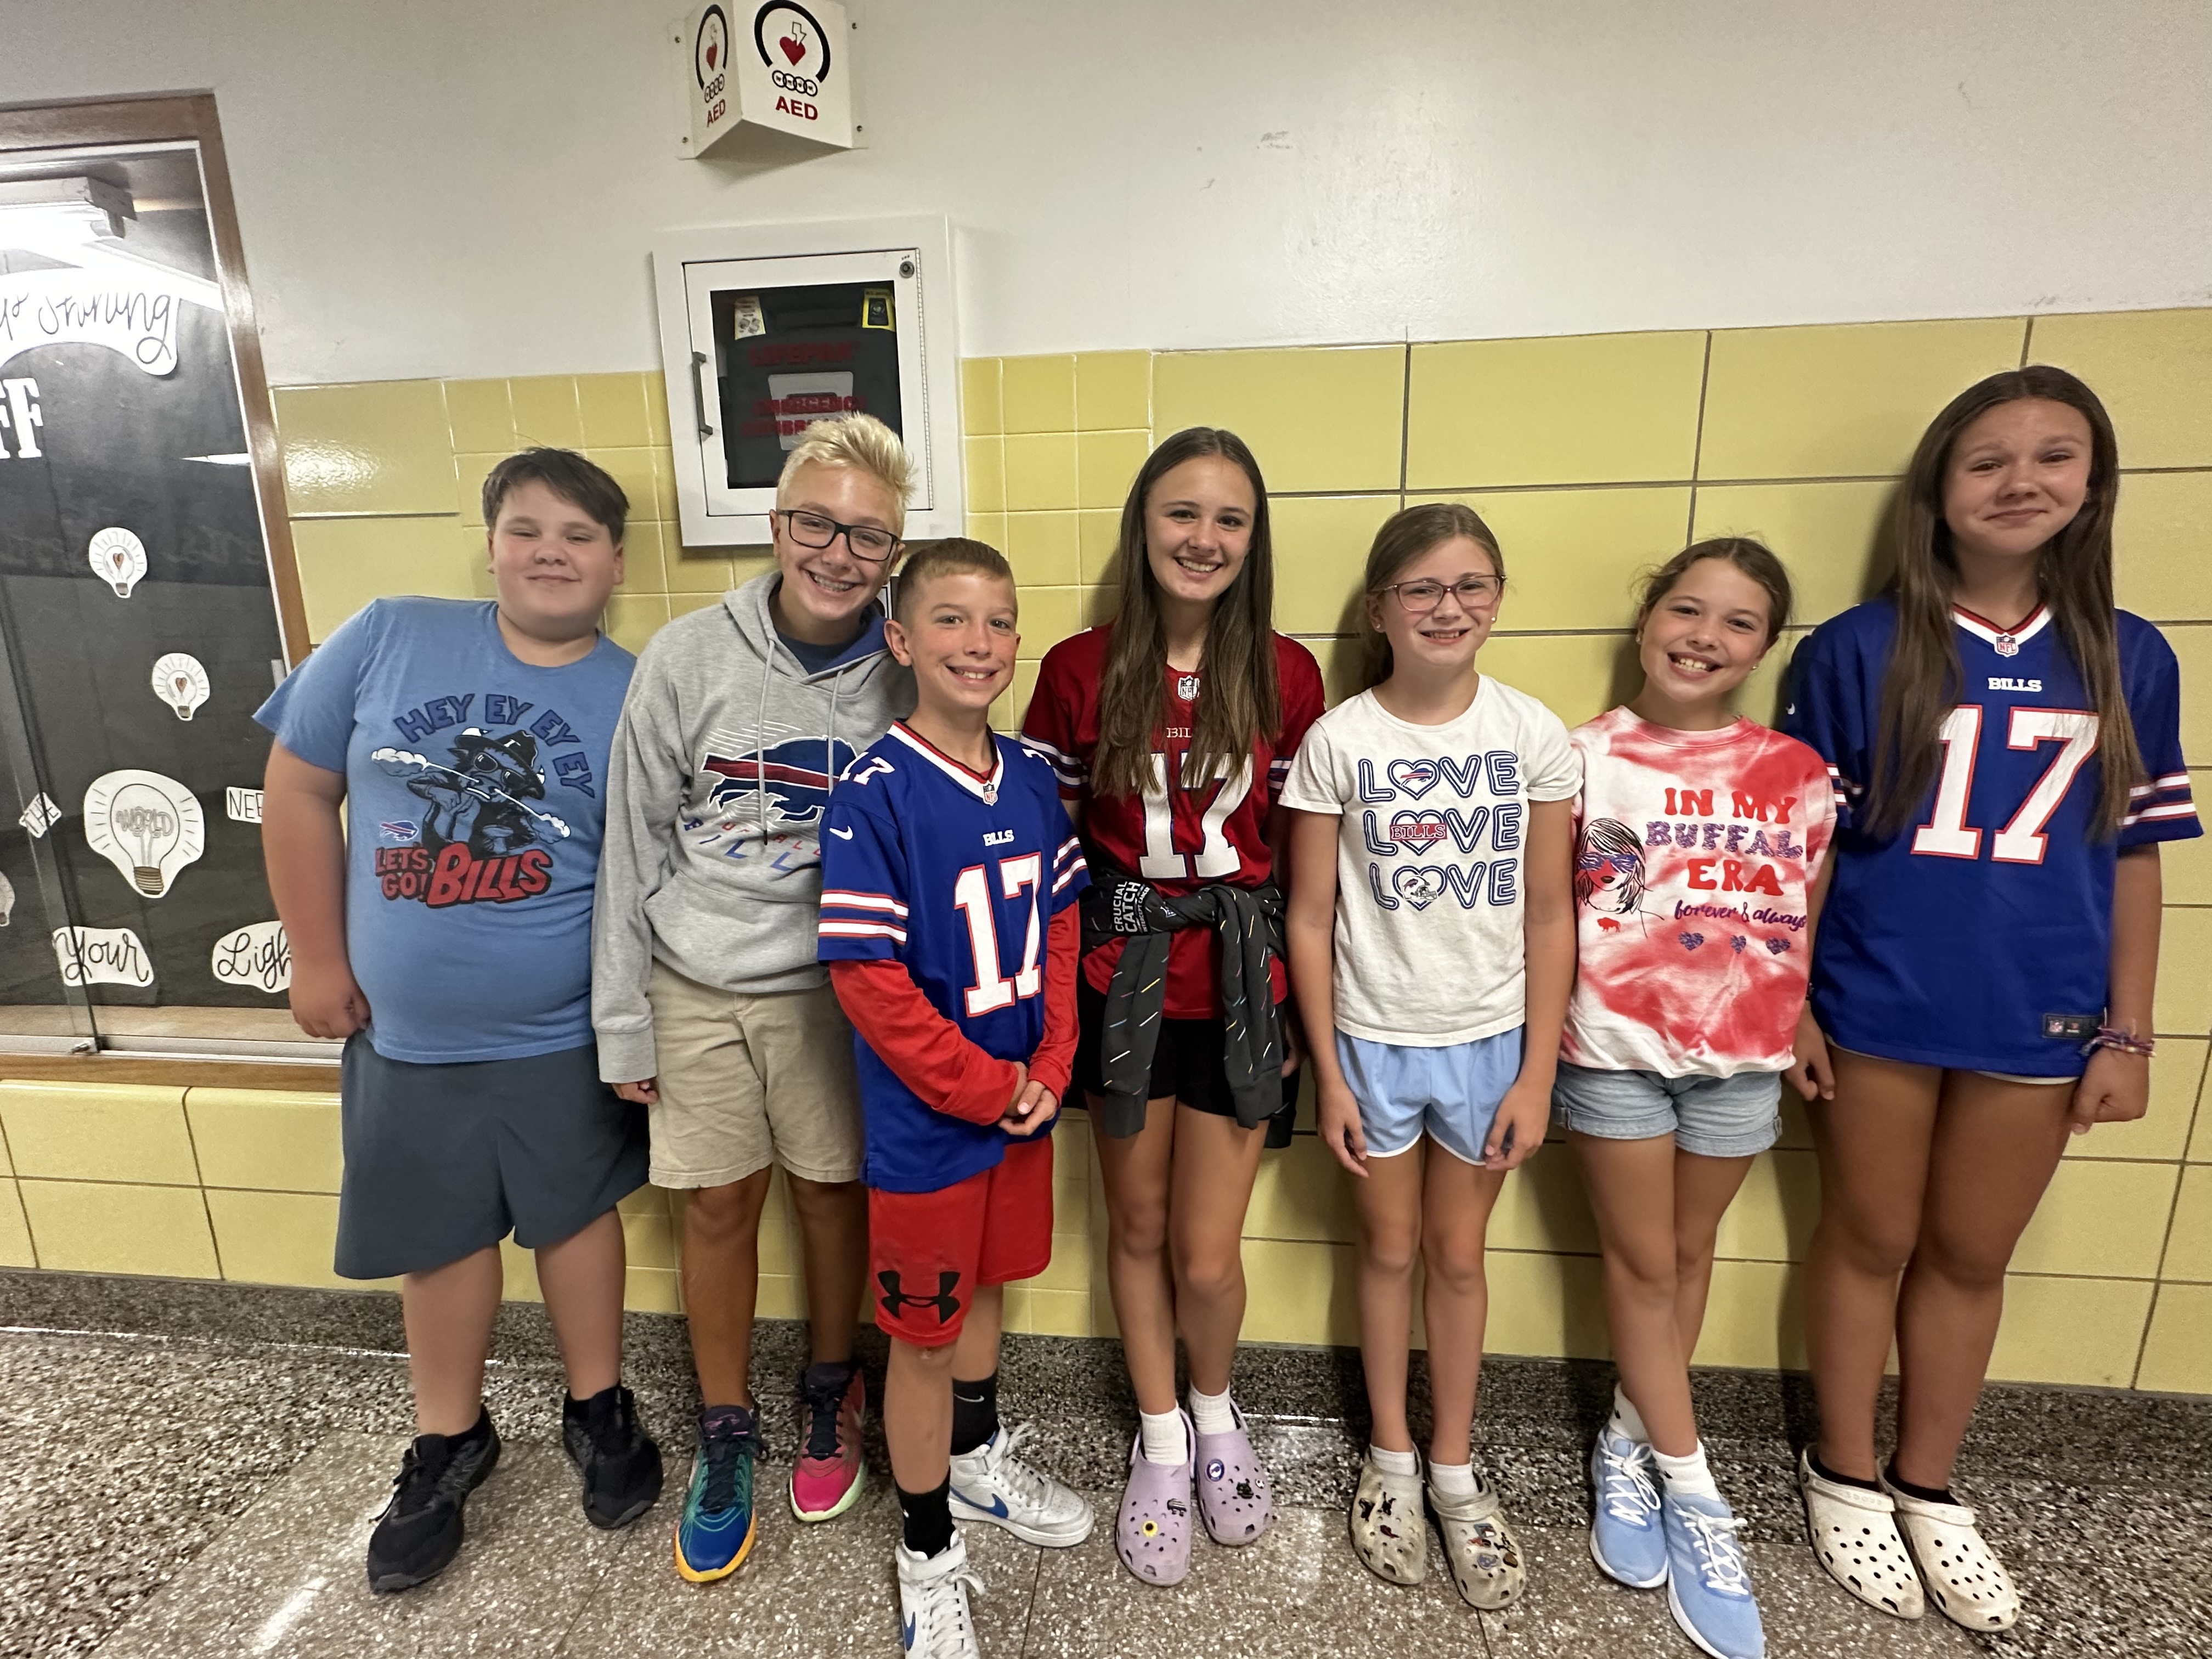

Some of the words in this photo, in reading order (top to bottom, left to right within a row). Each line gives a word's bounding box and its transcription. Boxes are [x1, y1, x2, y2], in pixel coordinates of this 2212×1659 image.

[707, 99, 725, 127] AED
[776, 96, 818, 120] AED
[1988, 677, 2042, 692] BILLS
[393, 693, 475, 743] HEY
[485, 693, 534, 725] EY
[529, 709, 581, 747] EY
[1166, 727, 1192, 738] BIL
[552, 752, 596, 799] EY
[839, 752, 895, 785] 17
[1911, 704, 2100, 865] 17
[229, 789, 263, 819] NEE
[1132, 749, 1254, 879] 17
[1664, 788, 1714, 816] IN
[1731, 791, 1797, 823] MY
[983, 830, 1014, 847] BILLS
[1391, 825, 1446, 839] BILLS
[1646, 821, 1804, 859] BUFFAL
[381, 873, 428, 902] GO!
[426, 841, 554, 908] BILLS
[1687, 858, 1784, 896] ERA
[1113, 881, 1127, 932] CRUCIAL
[1122, 882, 1141, 932] CATCH
[1138, 887, 1150, 903] CANCER
[1674, 900, 1738, 921] forever
[1741, 902, 1750, 922] &
[1753, 907, 1807, 932] always
[955, 851, 1041, 1017] 17
[55, 930, 149, 983] Your
[218, 926, 292, 989] Ligh
